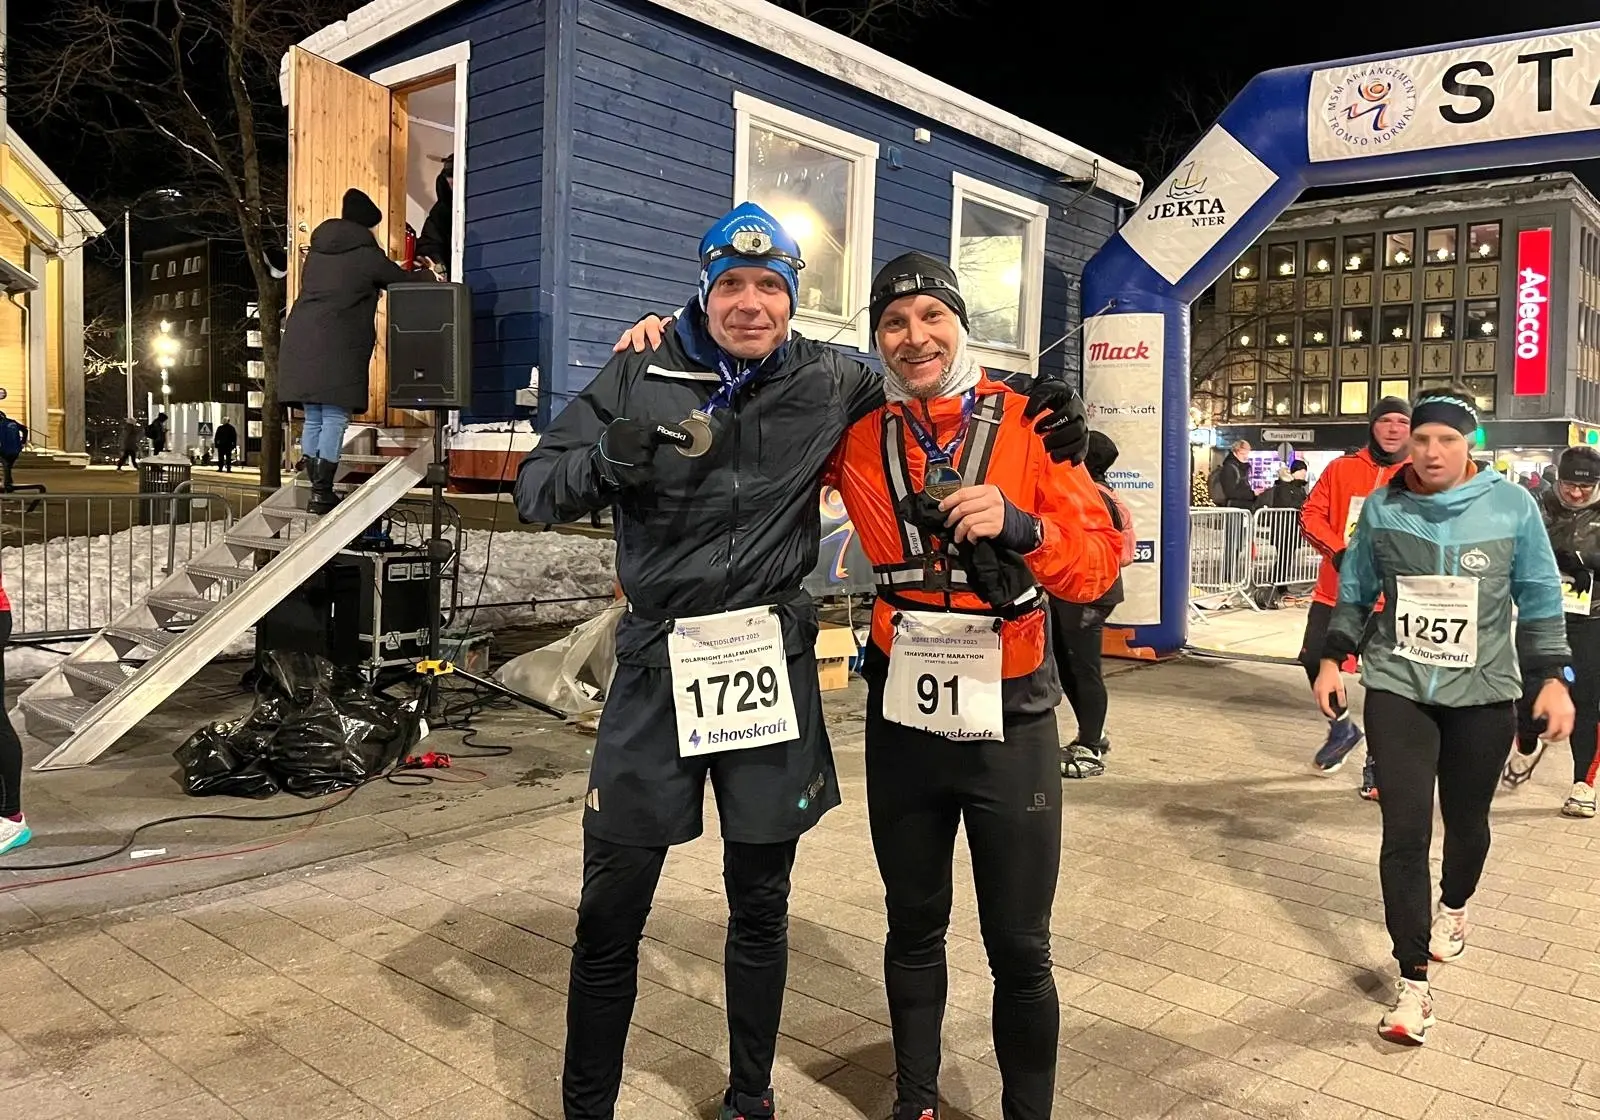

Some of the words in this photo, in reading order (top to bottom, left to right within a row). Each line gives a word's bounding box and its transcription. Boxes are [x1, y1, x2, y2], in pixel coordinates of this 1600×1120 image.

[1327, 86, 1344, 111] MSM
[1346, 67, 1416, 100] ARRANGEMENT
[1439, 48, 1600, 123] ST
[1373, 106, 1414, 145] NORWAY
[1147, 198, 1226, 221] JEKTA
[1517, 267, 1548, 360] Adecco
[1089, 340, 1150, 361] Mack
[1104, 471, 1140, 479] romsø
[1108, 480, 1154, 489] ommune
[1398, 613, 1468, 644] 1257
[681, 654, 721, 664] POLARNIGHT
[722, 645, 773, 659] HALFMARATHON
[904, 651, 945, 659] ISHAVSKRAFT
[1409, 646, 1469, 662] Ishavskraft
[686, 666, 779, 718] 1729
[917, 674, 960, 716] 91
[707, 718, 788, 744] Ishavskraft
